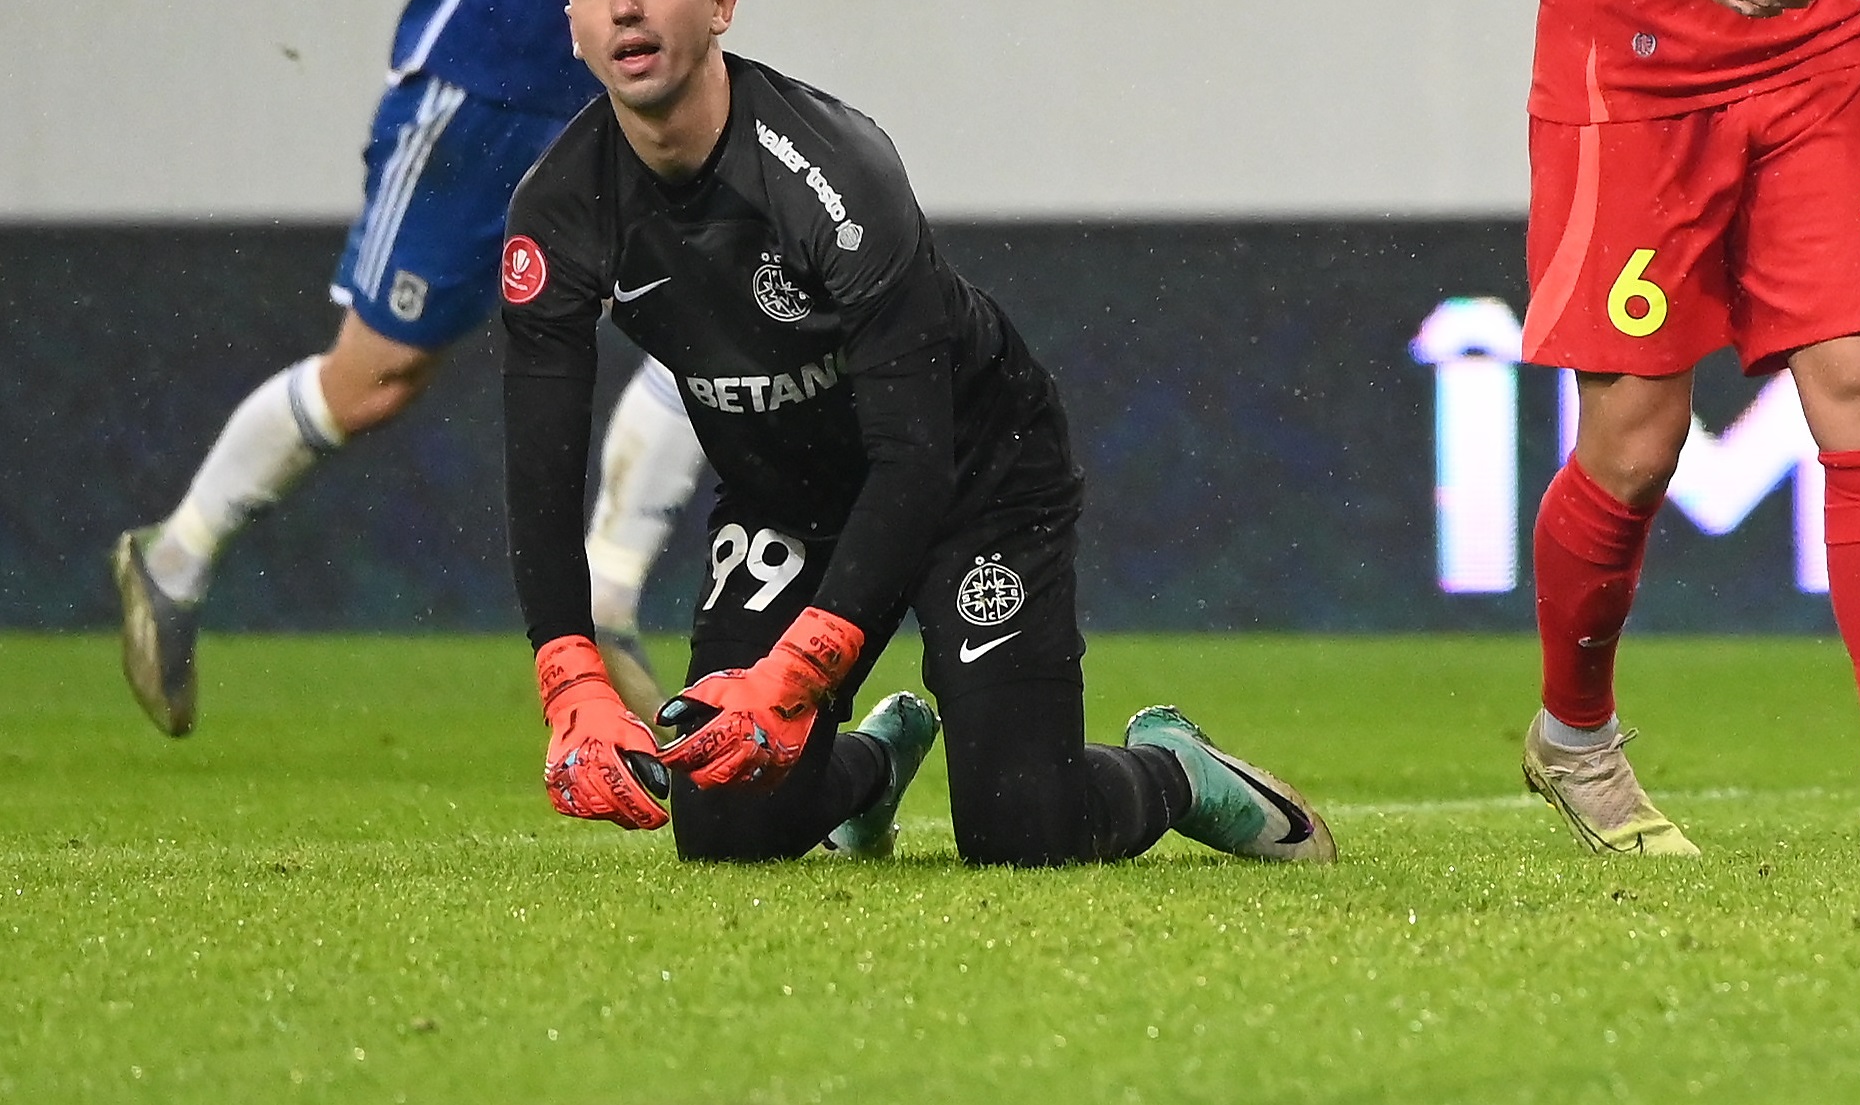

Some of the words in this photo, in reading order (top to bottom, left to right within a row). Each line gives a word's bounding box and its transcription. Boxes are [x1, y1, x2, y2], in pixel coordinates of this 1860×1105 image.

[806, 166, 847, 222] tosto
[1607, 249, 1668, 337] 6
[686, 352, 849, 414] BETAN
[702, 523, 806, 612] 99
